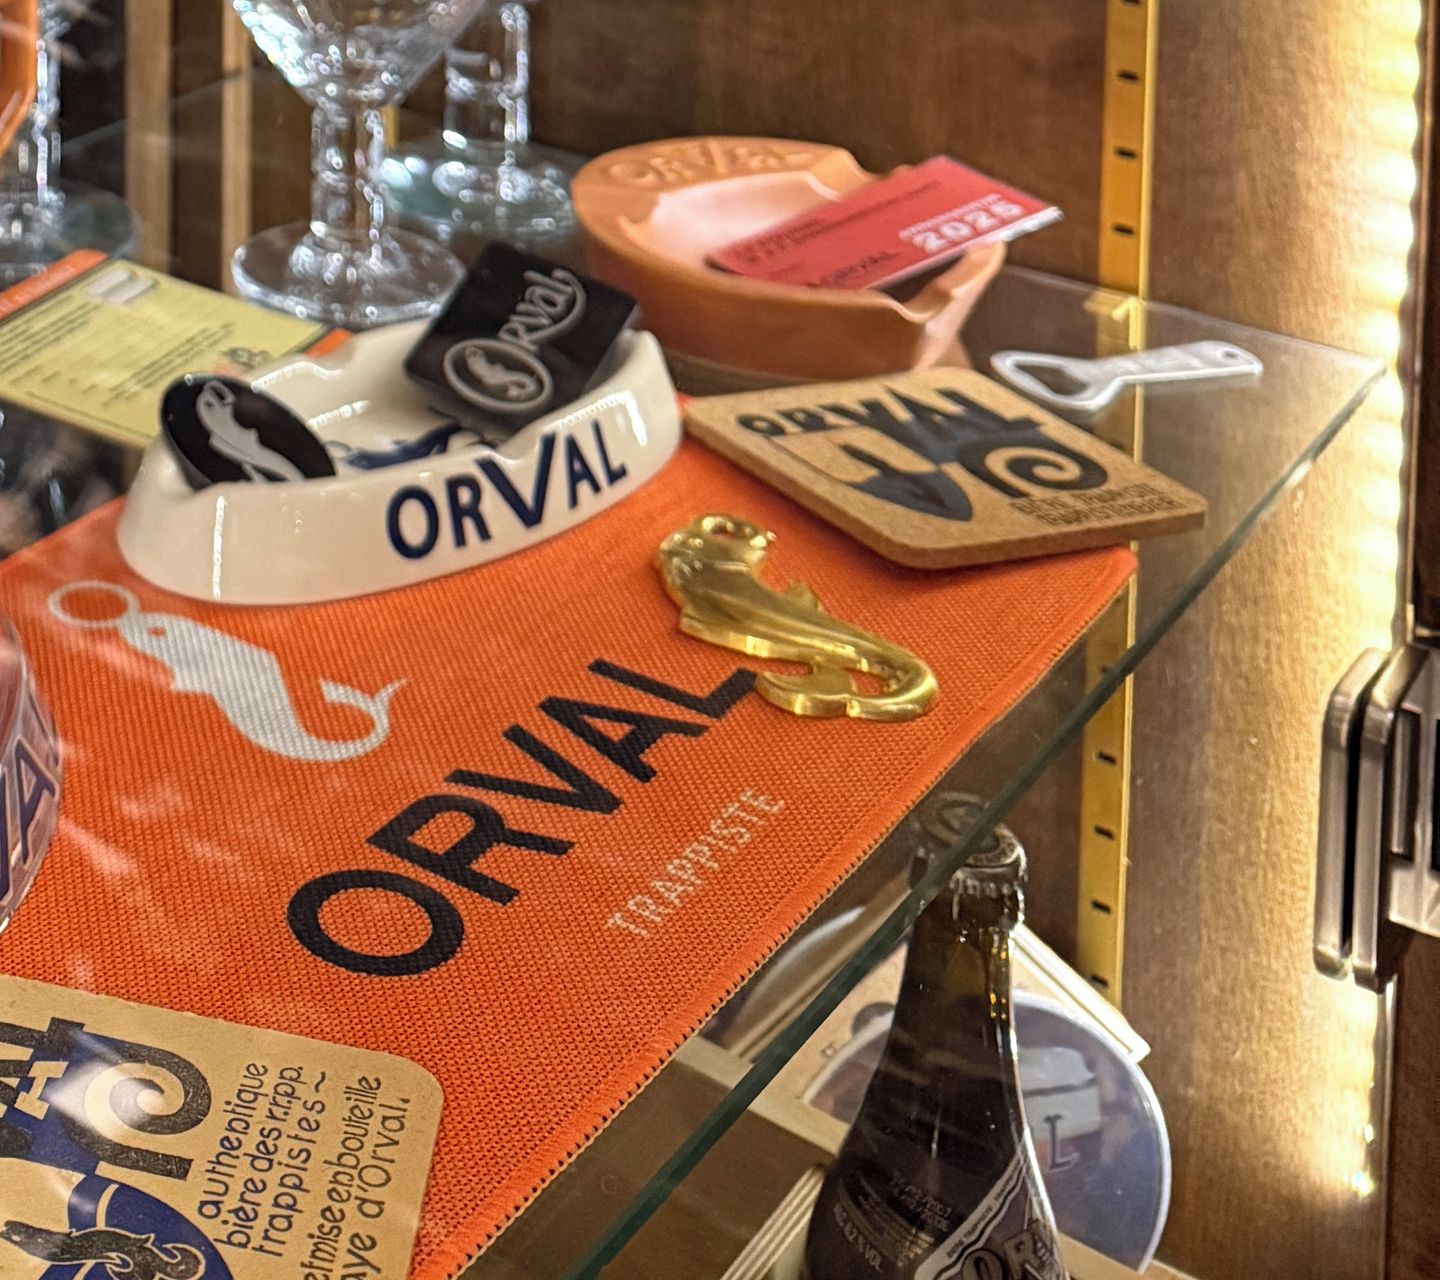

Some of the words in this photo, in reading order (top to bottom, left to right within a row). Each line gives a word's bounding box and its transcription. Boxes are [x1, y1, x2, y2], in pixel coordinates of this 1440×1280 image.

[385, 419, 628, 560] ORVAL
[735, 385, 1044, 463] ORVAL
[287, 657, 759, 977] ORVAL
[605, 786, 786, 938] TRAPPISTE
[197, 1062, 269, 1220] authentique
[213, 1177, 268, 1250] bière
[243, 1126, 283, 1173] des
[251, 1099, 327, 1257] trappistes
[354, 1097, 411, 1220] d'Orval.
